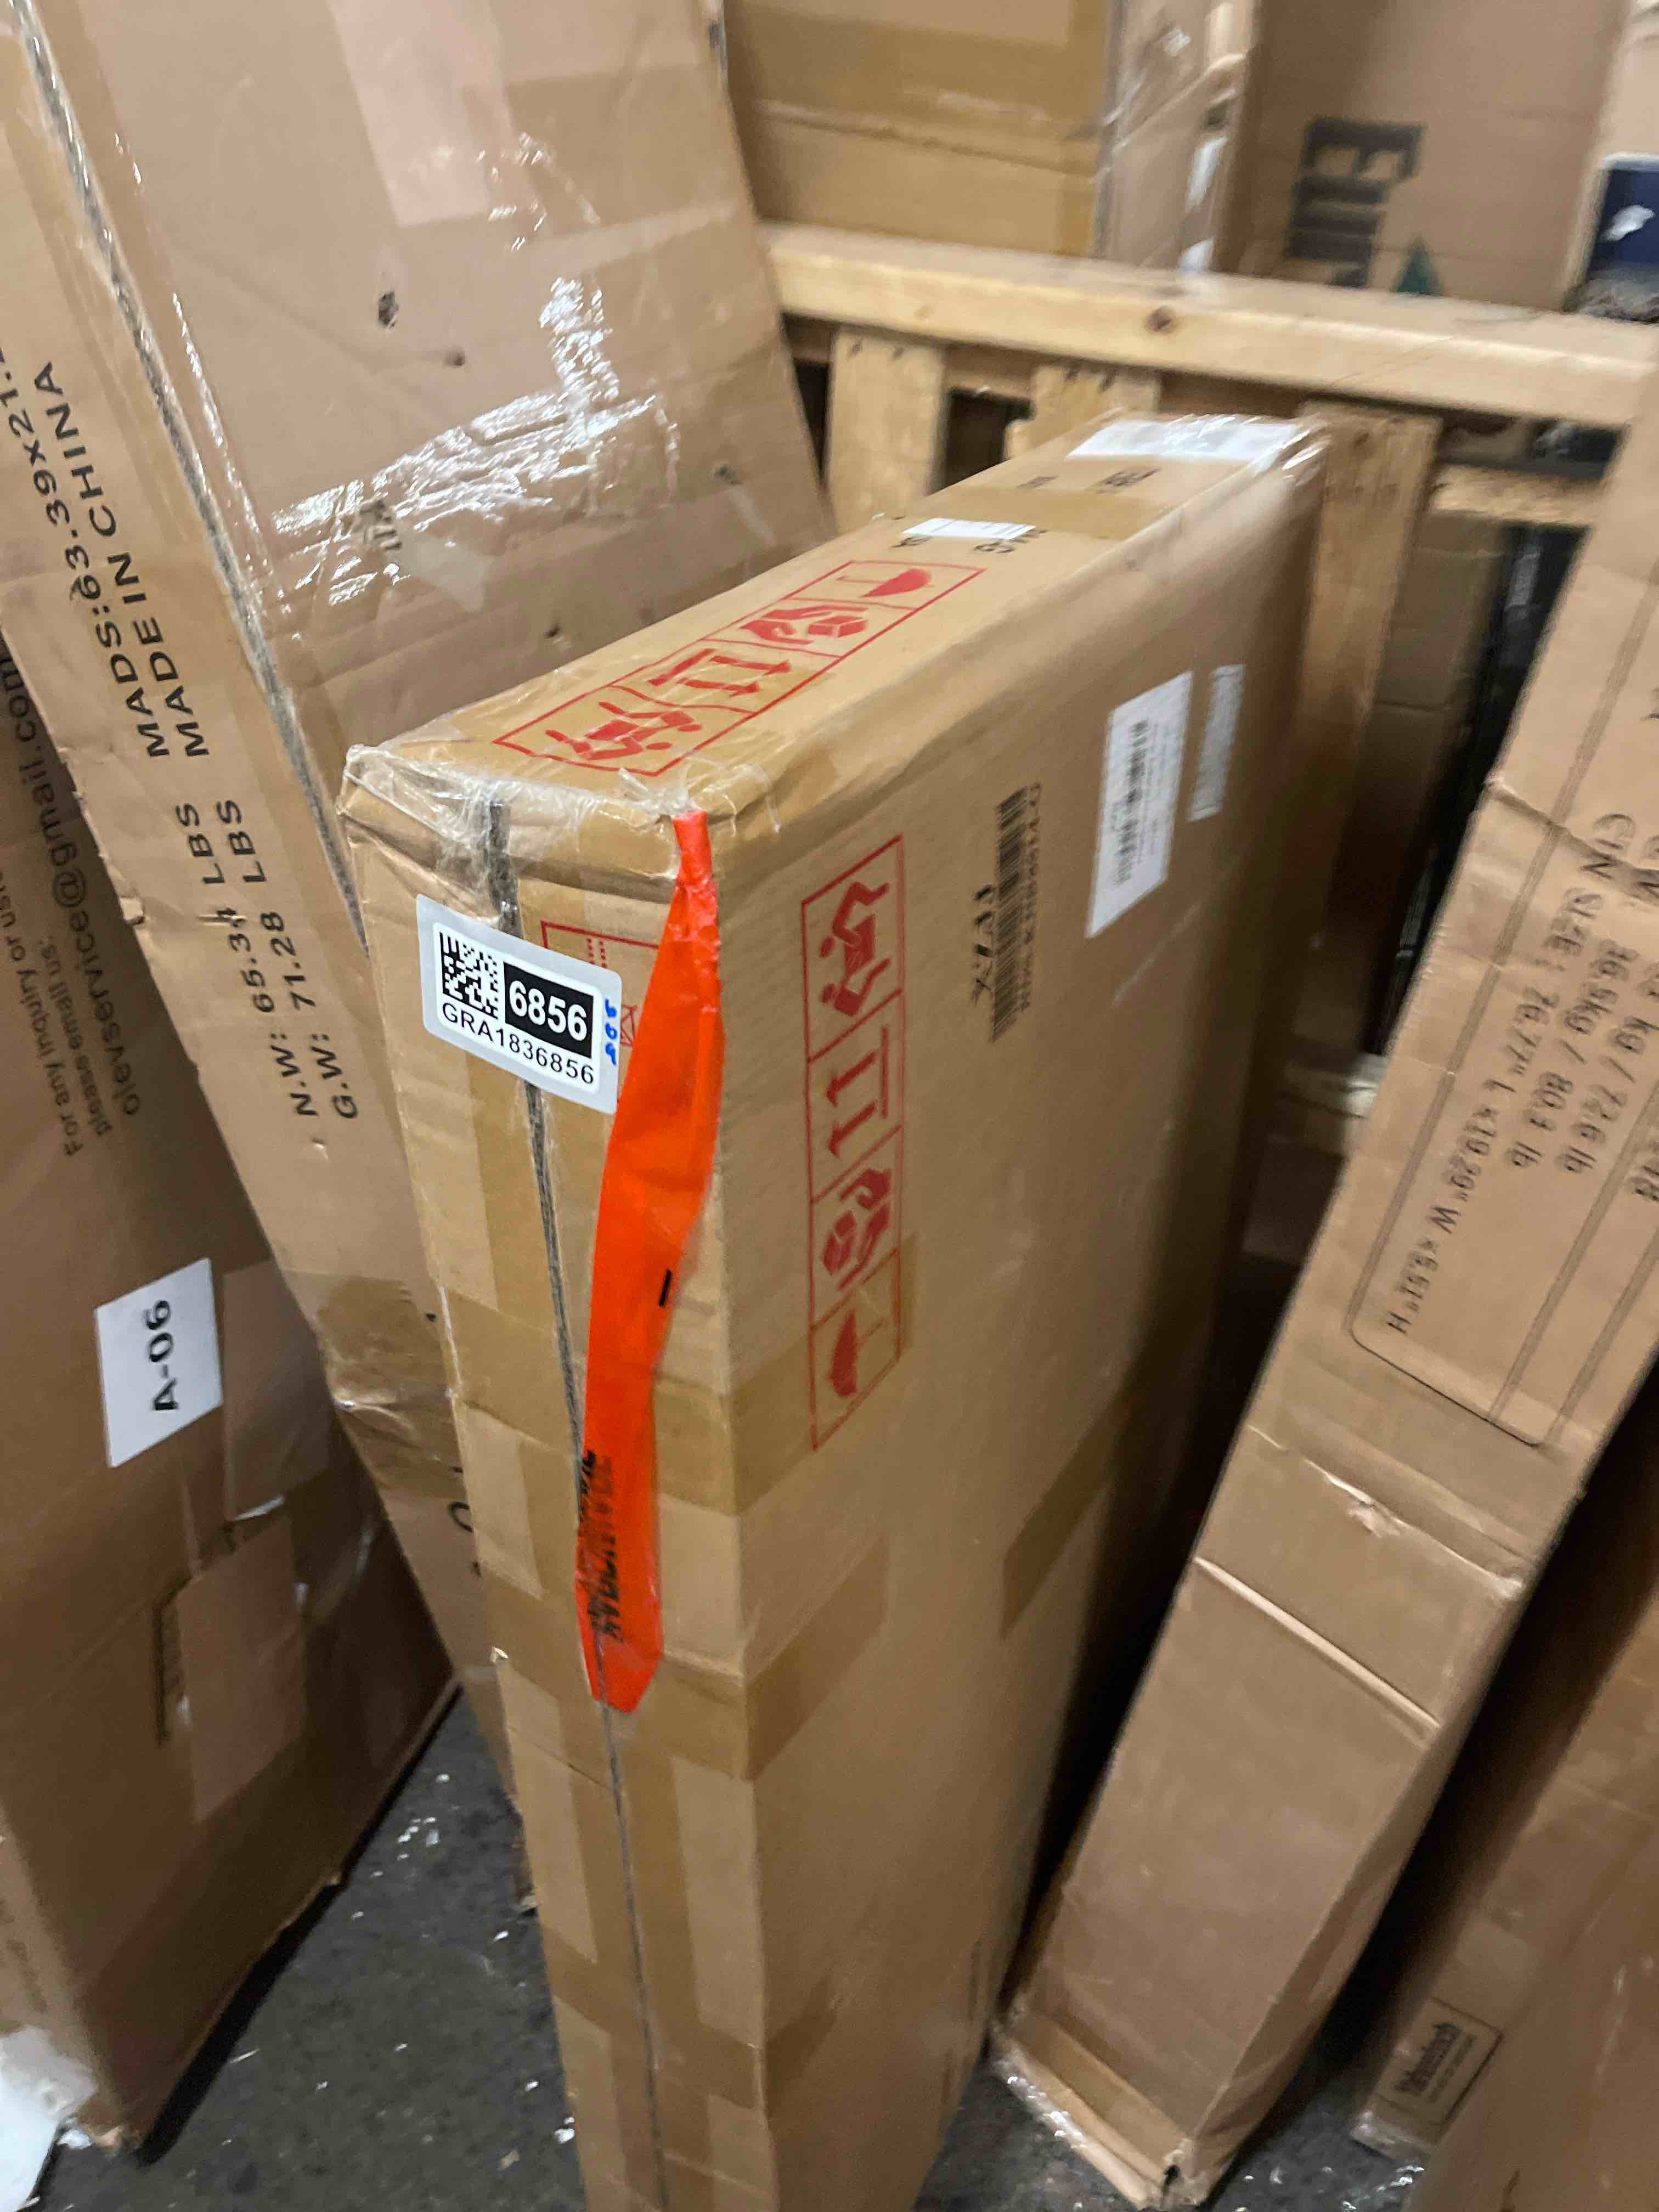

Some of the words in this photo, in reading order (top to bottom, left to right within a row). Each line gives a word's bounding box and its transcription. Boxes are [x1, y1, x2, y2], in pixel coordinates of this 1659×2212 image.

[35, 362, 116, 537] CHINA
[0, 347, 170, 757] MADS:63.39x21.
[108, 552, 148, 604] IN
[133, 618, 209, 757] MADE
[176, 803, 225, 884] LBS
[217, 799, 267, 883] LBS
[7, 936, 26, 962] or
[261, 911, 317, 1011] 71.28
[18, 969, 55, 1059] inquiry
[442, 1002, 594, 1084] GRA1836856
[509, 980, 588, 1042] 6856
[45, 1062, 70, 1106] any
[270, 1032, 318, 1116] N.W:
[311, 1032, 359, 1119] G.W:
[1427, 1205, 1462, 1235] W
[144, 1299, 179, 1410] A-06
[1385, 1310, 1412, 1335] H
